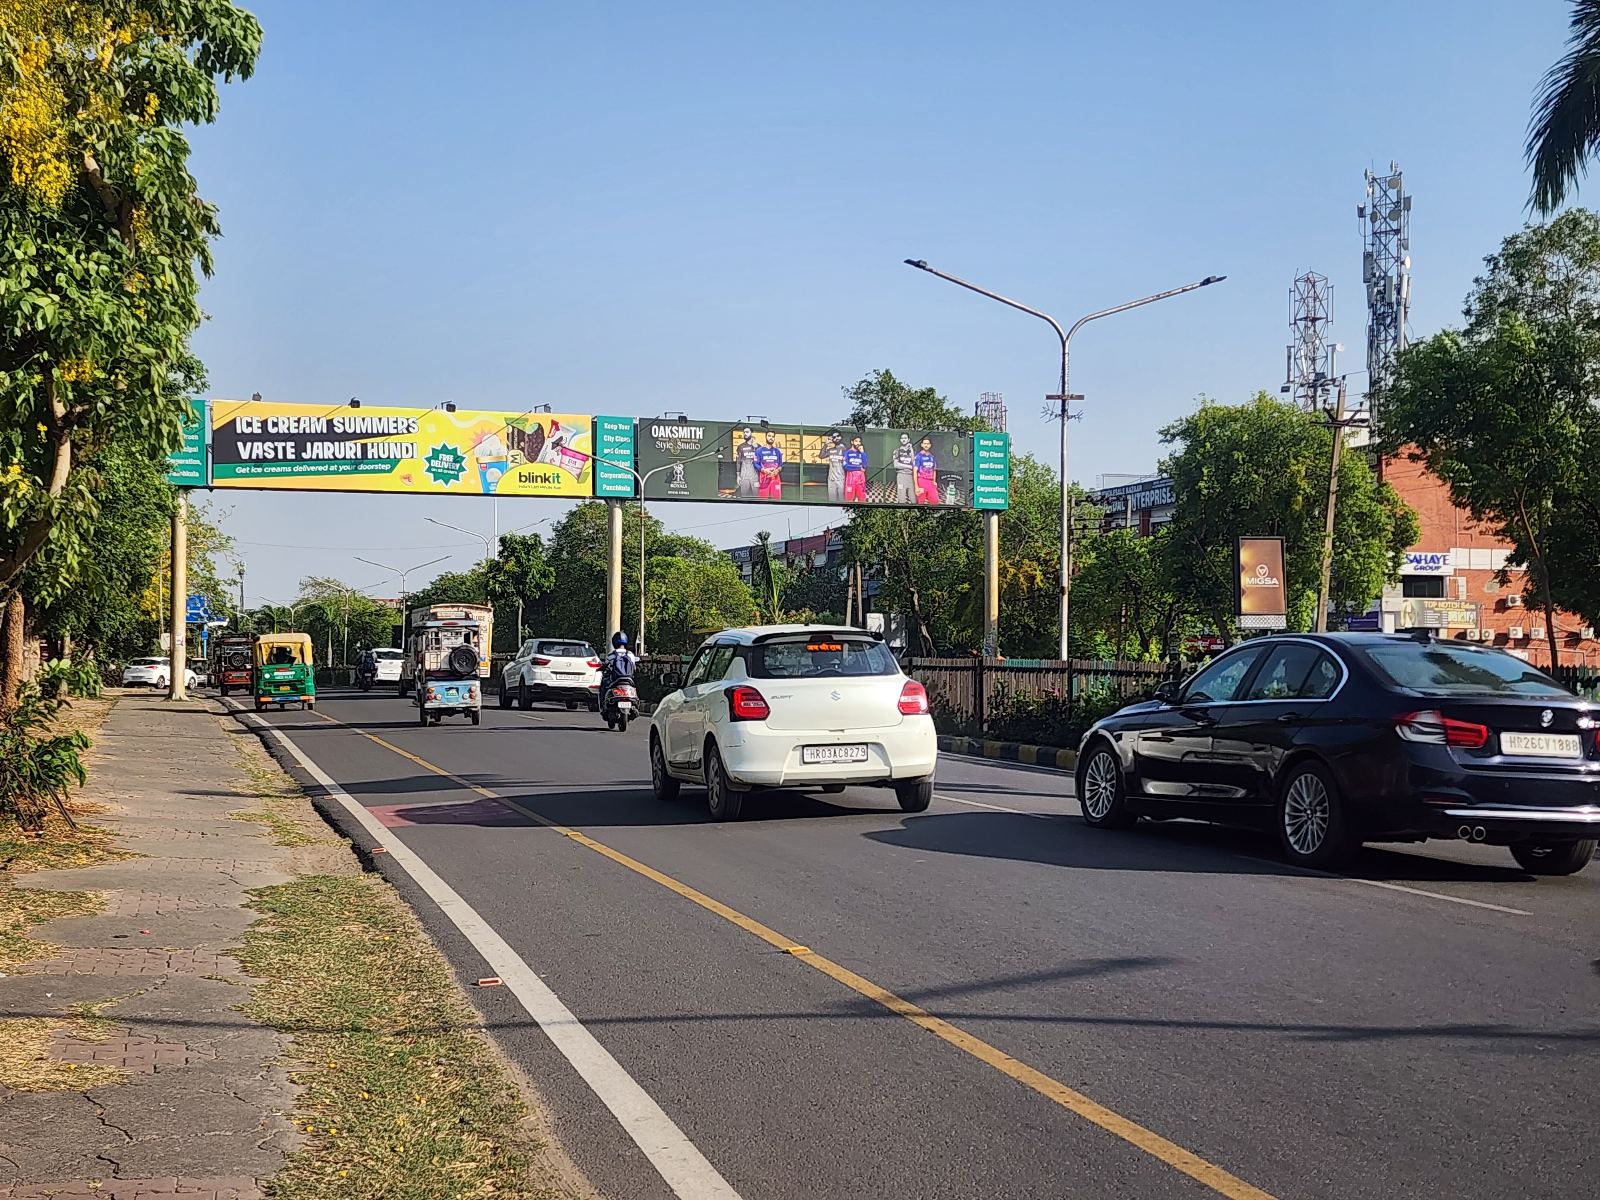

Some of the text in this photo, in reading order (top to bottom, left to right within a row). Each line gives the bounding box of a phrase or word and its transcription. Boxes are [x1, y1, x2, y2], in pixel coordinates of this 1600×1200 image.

[236, 416, 419, 434] ICE CREAM SUMMERS
[604, 422, 630, 431] Keep Your
[652, 425, 704, 440] OAKSMITH
[603, 435, 615, 443] City
[237, 442, 418, 460] VASTE JARURI HUNDI
[655, 440, 701, 452] Style Studio
[439, 454, 454, 462] FREE
[292, 464, 328, 472] delivered
[338, 466, 356, 474] your
[357, 463, 390, 472] doorstep
[430, 460, 460, 470] DELIVERY
[518, 472, 561, 484] blinkit
[1131, 486, 1176, 511] NTERPRISES
[1405, 554, 1449, 565] SAHAYE
[810, 748, 866, 759] HR03AC8279
